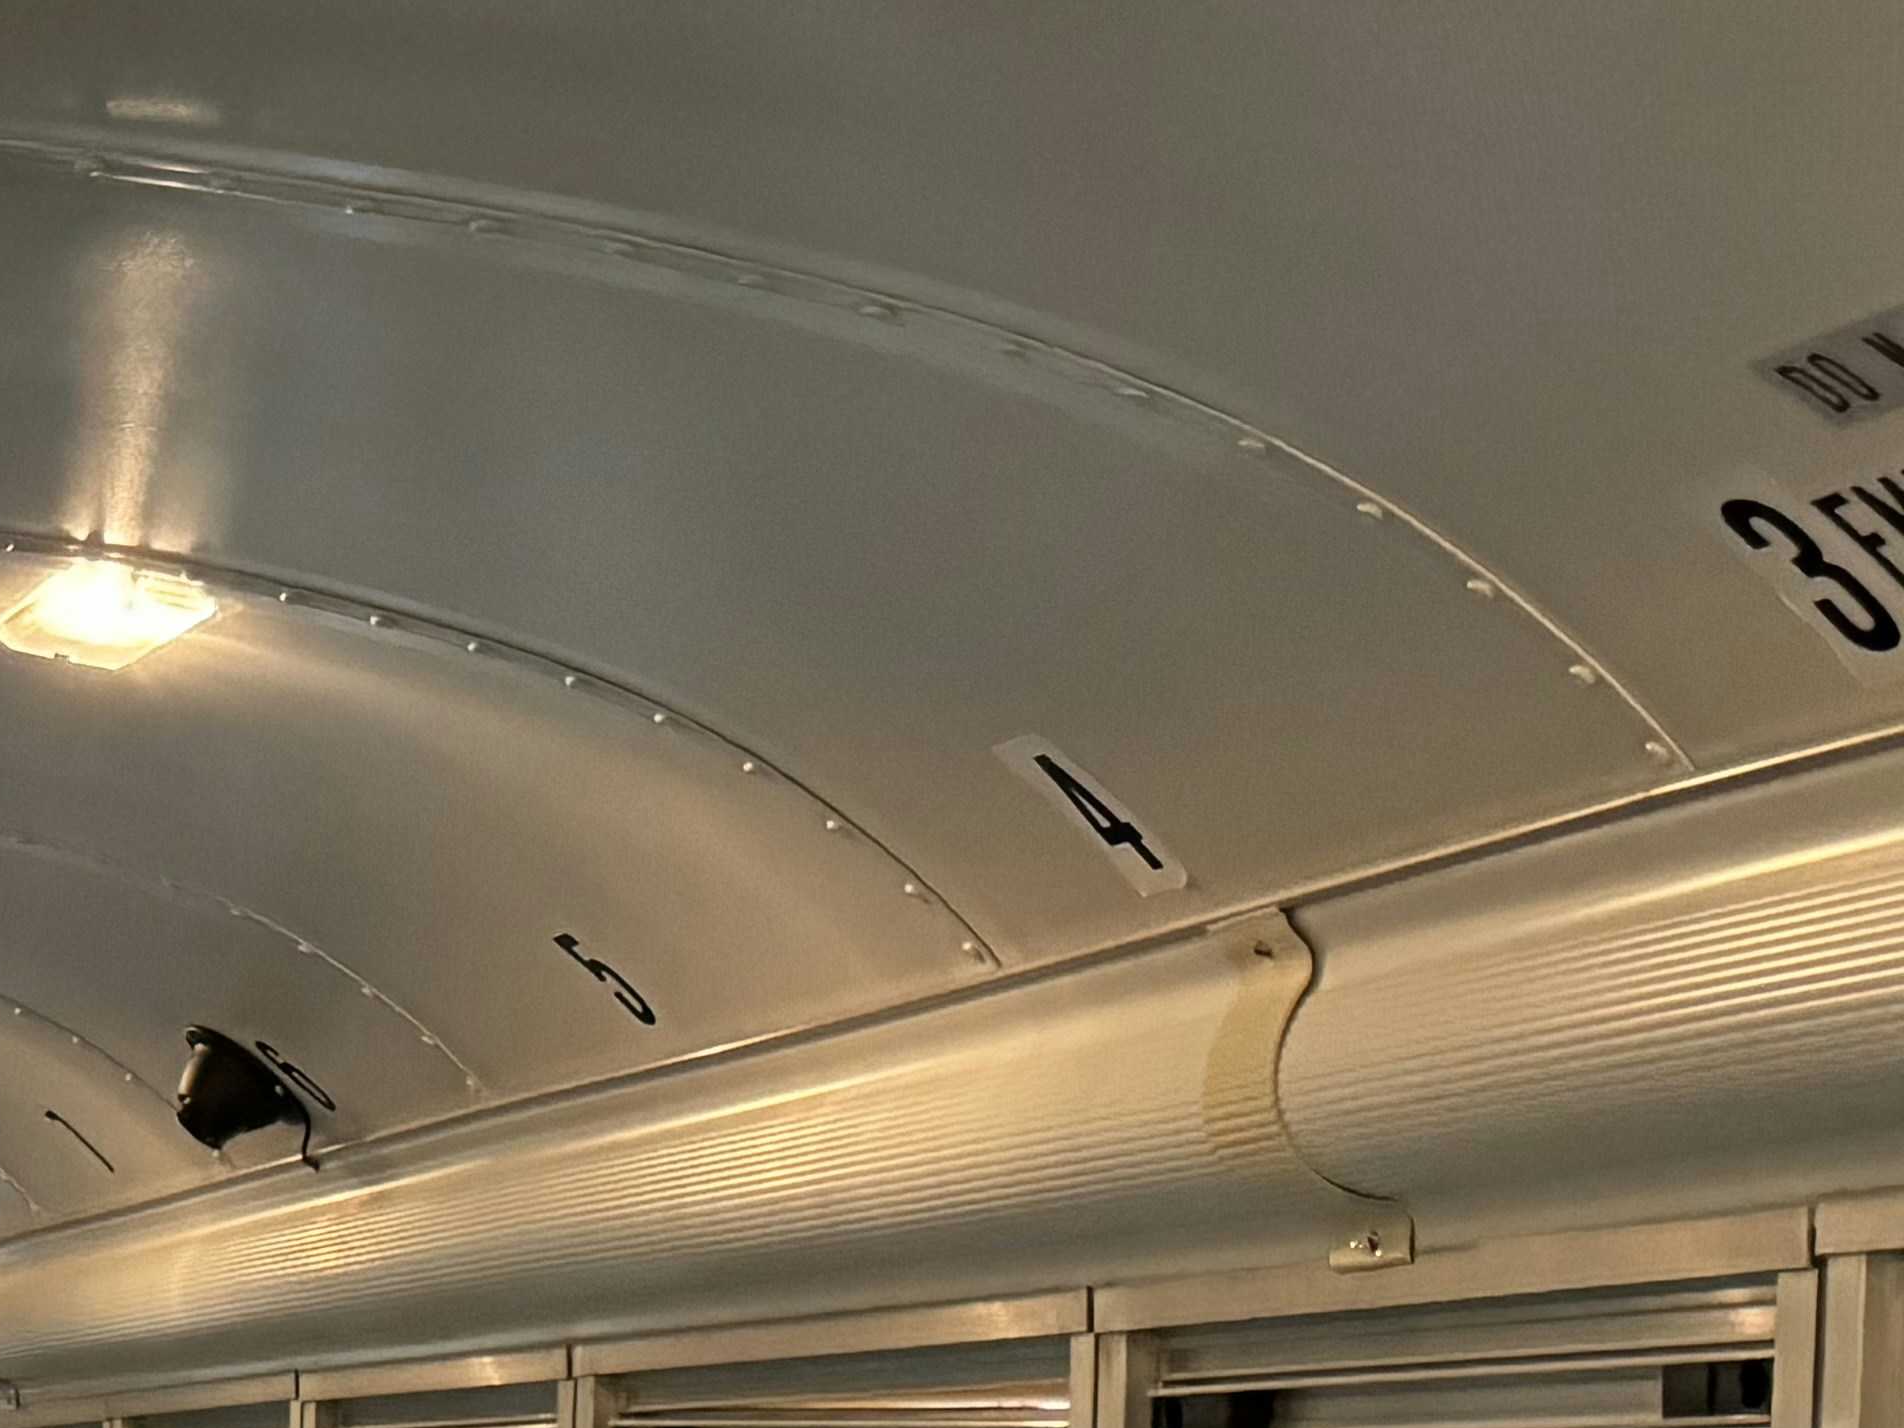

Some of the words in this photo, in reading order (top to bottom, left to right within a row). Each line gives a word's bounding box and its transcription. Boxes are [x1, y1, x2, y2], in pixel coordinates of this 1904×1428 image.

[1774, 352, 1882, 413] DO
[1720, 498, 1902, 652] 3
[1033, 753, 1164, 871] 4
[552, 932, 657, 1026] 5
